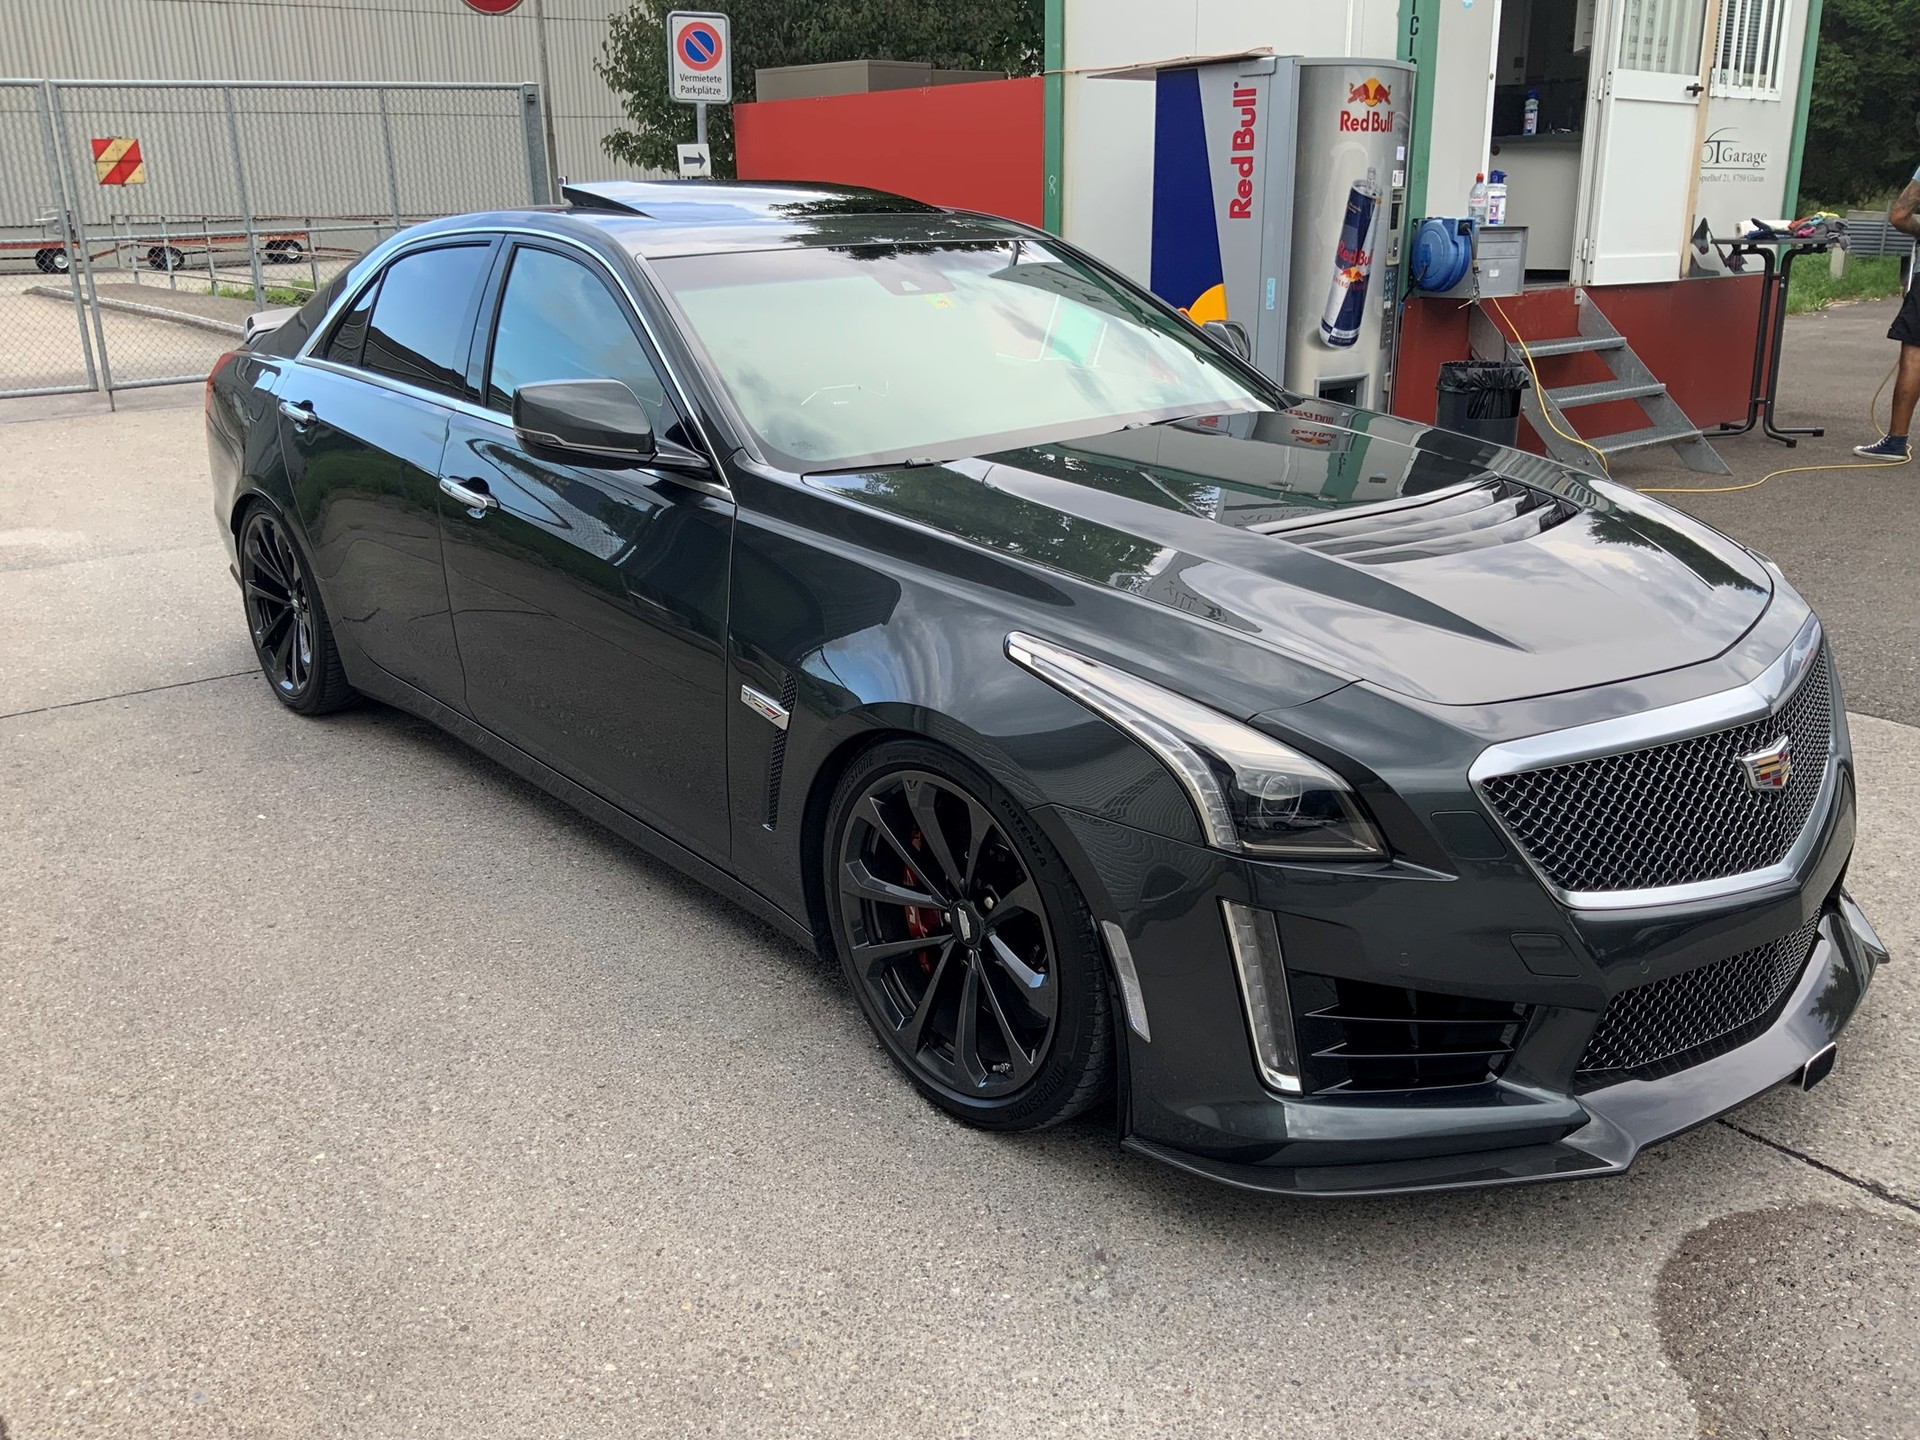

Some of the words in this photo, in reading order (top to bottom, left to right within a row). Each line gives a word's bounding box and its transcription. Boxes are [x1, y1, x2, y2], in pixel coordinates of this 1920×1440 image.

[679, 73, 722, 84] Vermietete
[680, 85, 721, 96] Parkplätze
[1232, 88, 1257, 151] Bull
[1340, 110, 1370, 132] Red
[1371, 110, 1394, 133] Bull
[1229, 156, 1254, 219] Red
[1000, 799, 1047, 868] POTENZA
